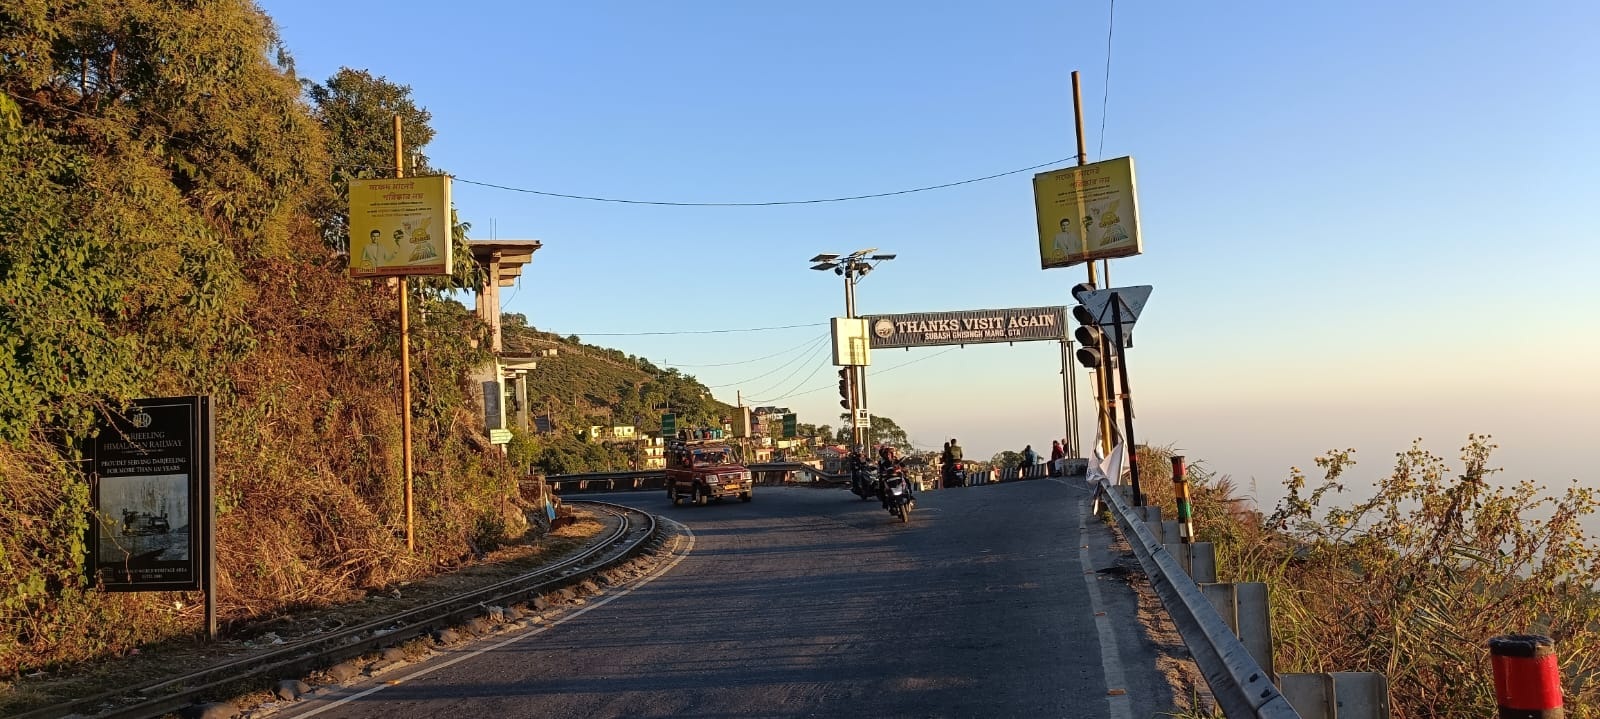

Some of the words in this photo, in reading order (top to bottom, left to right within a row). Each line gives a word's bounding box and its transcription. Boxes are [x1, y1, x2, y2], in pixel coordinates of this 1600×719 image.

[896, 319, 958, 333] THANKS
[962, 317, 1003, 330] VISIT
[1009, 314, 1054, 328] AGAIN
[925, 331, 951, 340] SUBASH
[1008, 329, 1021, 337] GTA
[120, 432, 165, 441] DRJEELING
[149, 440, 183, 449] RAILWAY
